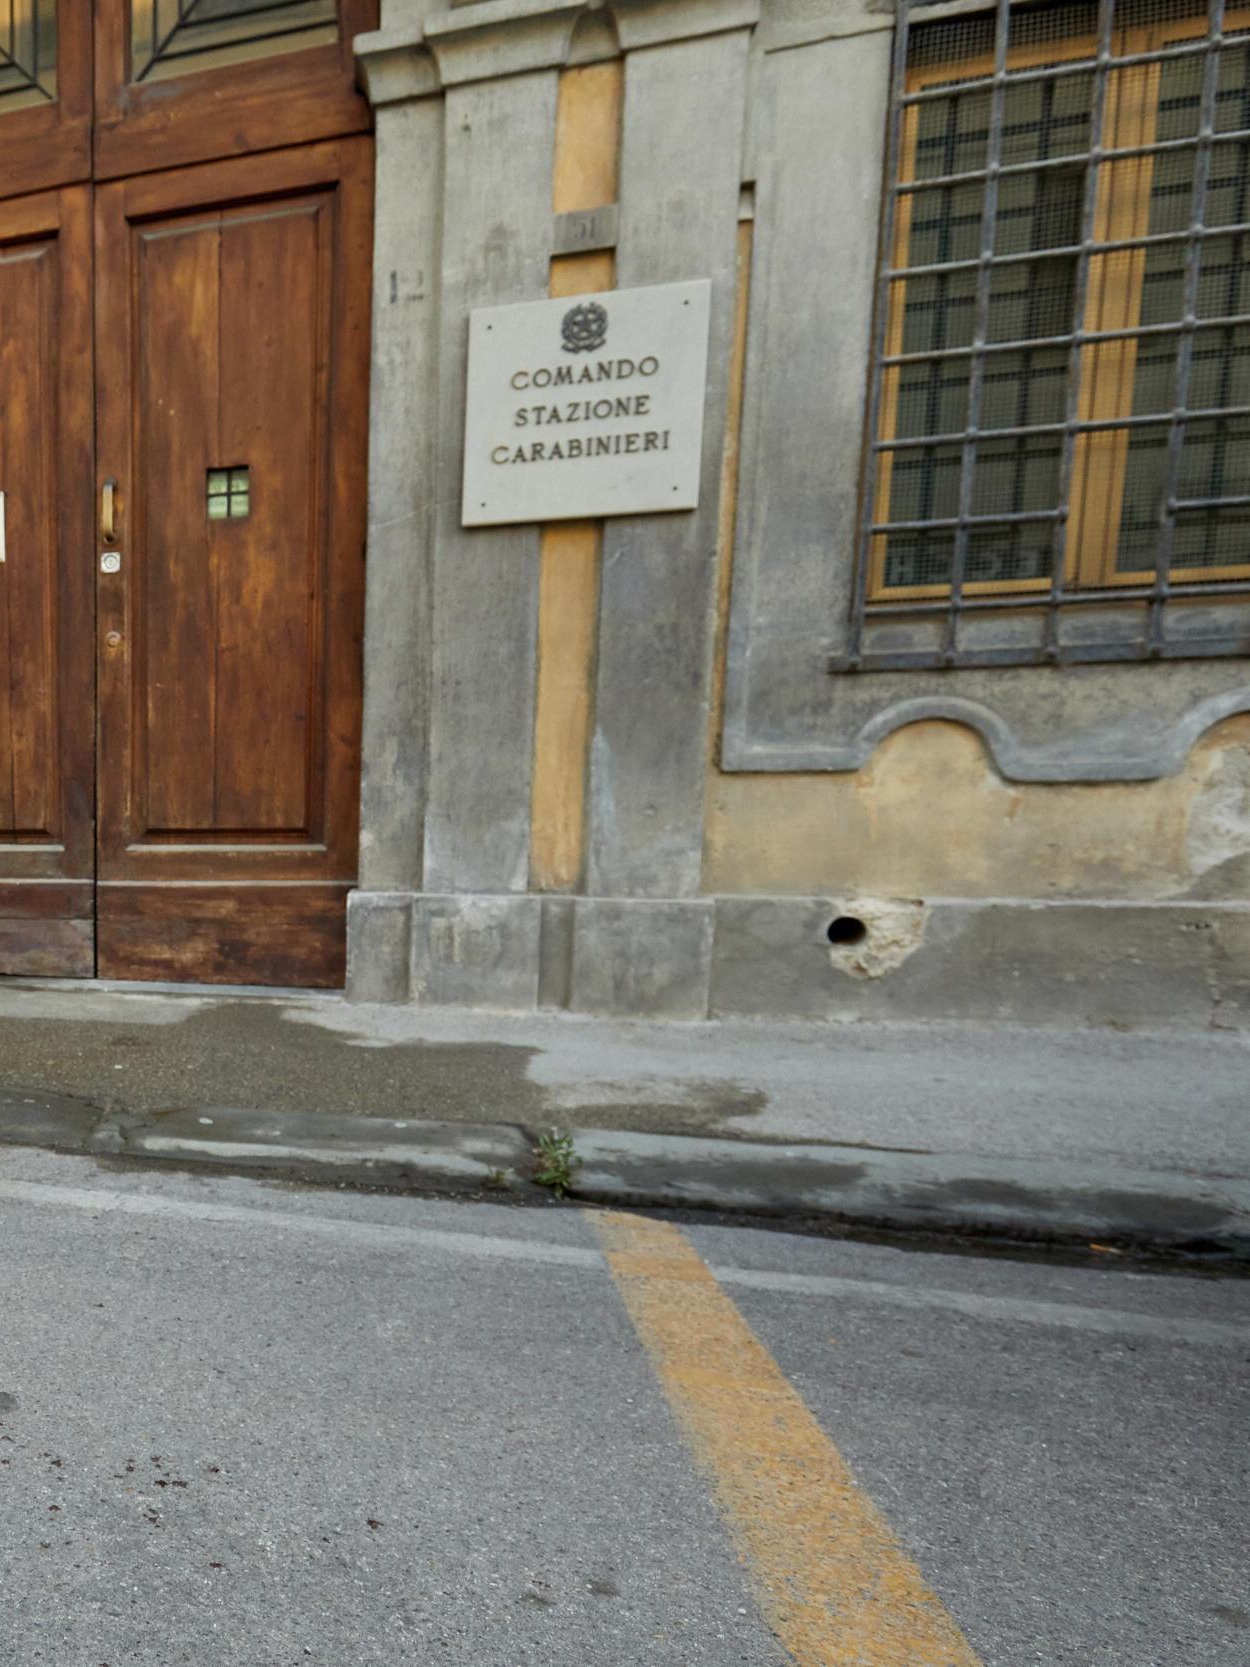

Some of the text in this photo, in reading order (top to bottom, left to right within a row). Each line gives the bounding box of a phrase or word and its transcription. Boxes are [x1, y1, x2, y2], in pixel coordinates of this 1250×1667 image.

[511, 356, 659, 390] COMANDO
[514, 395, 650, 426] STAZIONE
[491, 431, 670, 464] CARABINIERI
